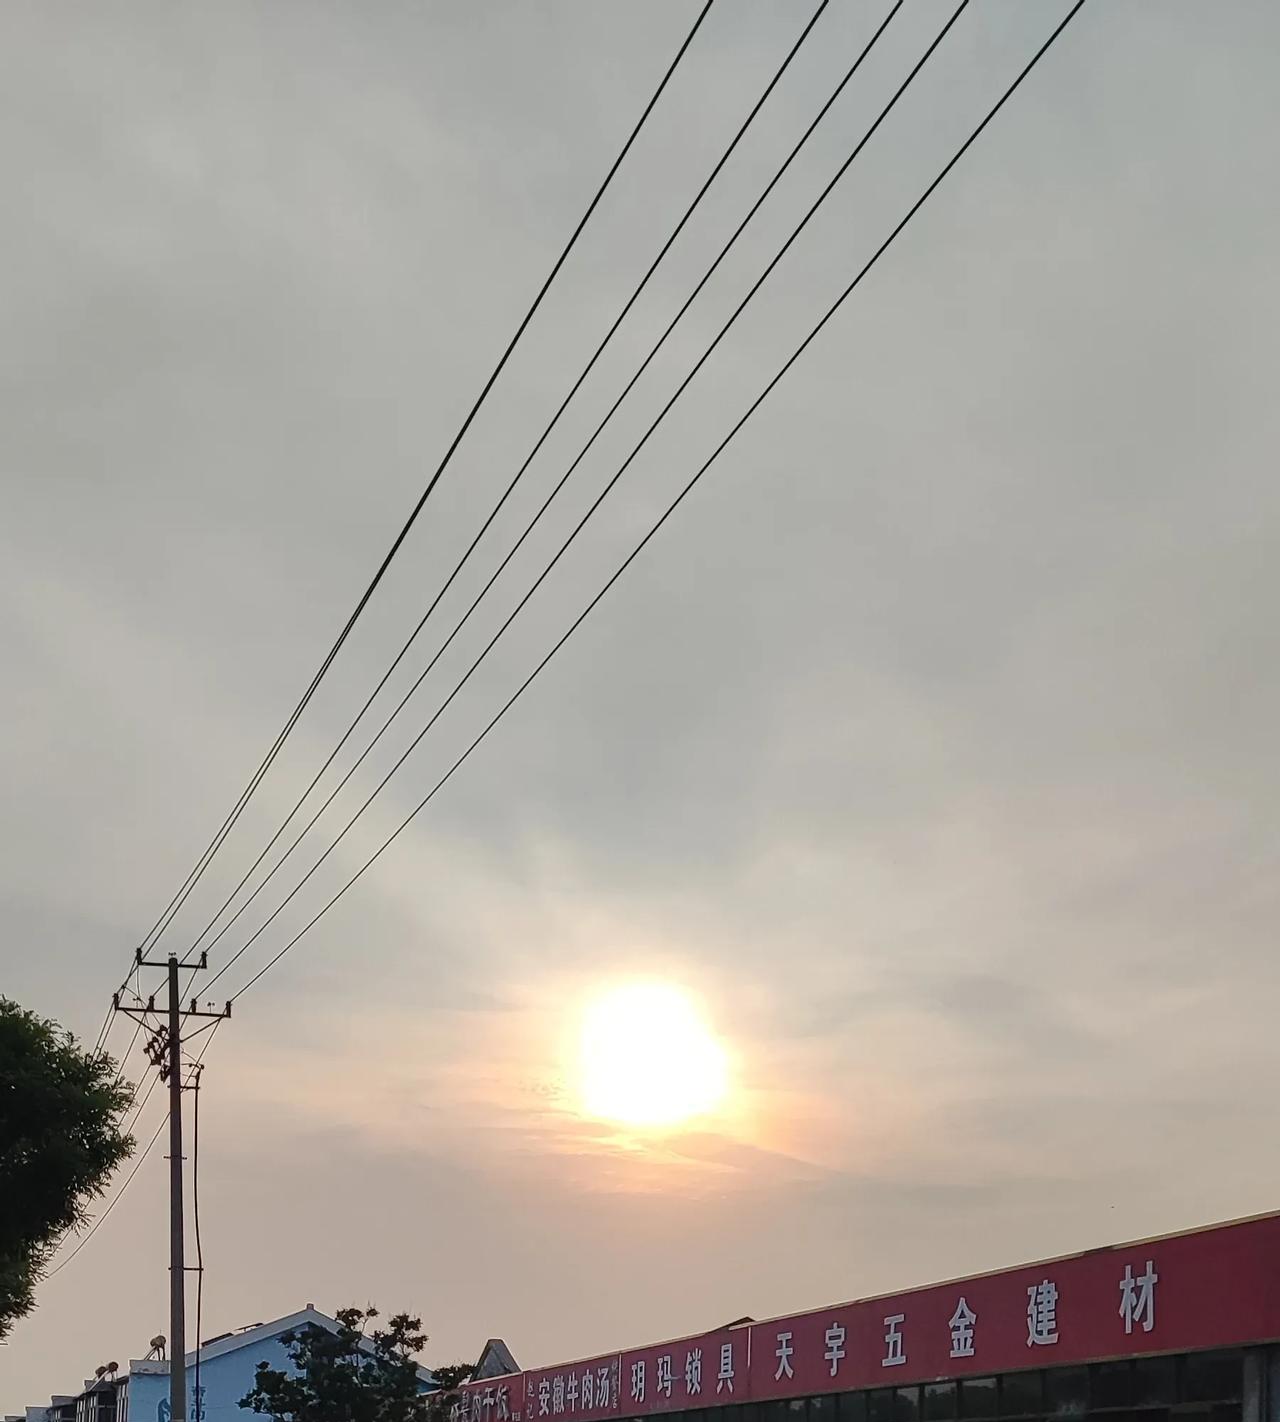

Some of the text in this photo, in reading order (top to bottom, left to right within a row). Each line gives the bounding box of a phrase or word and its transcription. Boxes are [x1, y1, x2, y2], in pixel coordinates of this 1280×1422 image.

[773, 1260, 1159, 1382] 天宇五金建材
[538, 1367, 610, 1417] 安徽牛肉汤
[630, 1343, 735, 1403] 玥玛锁具
